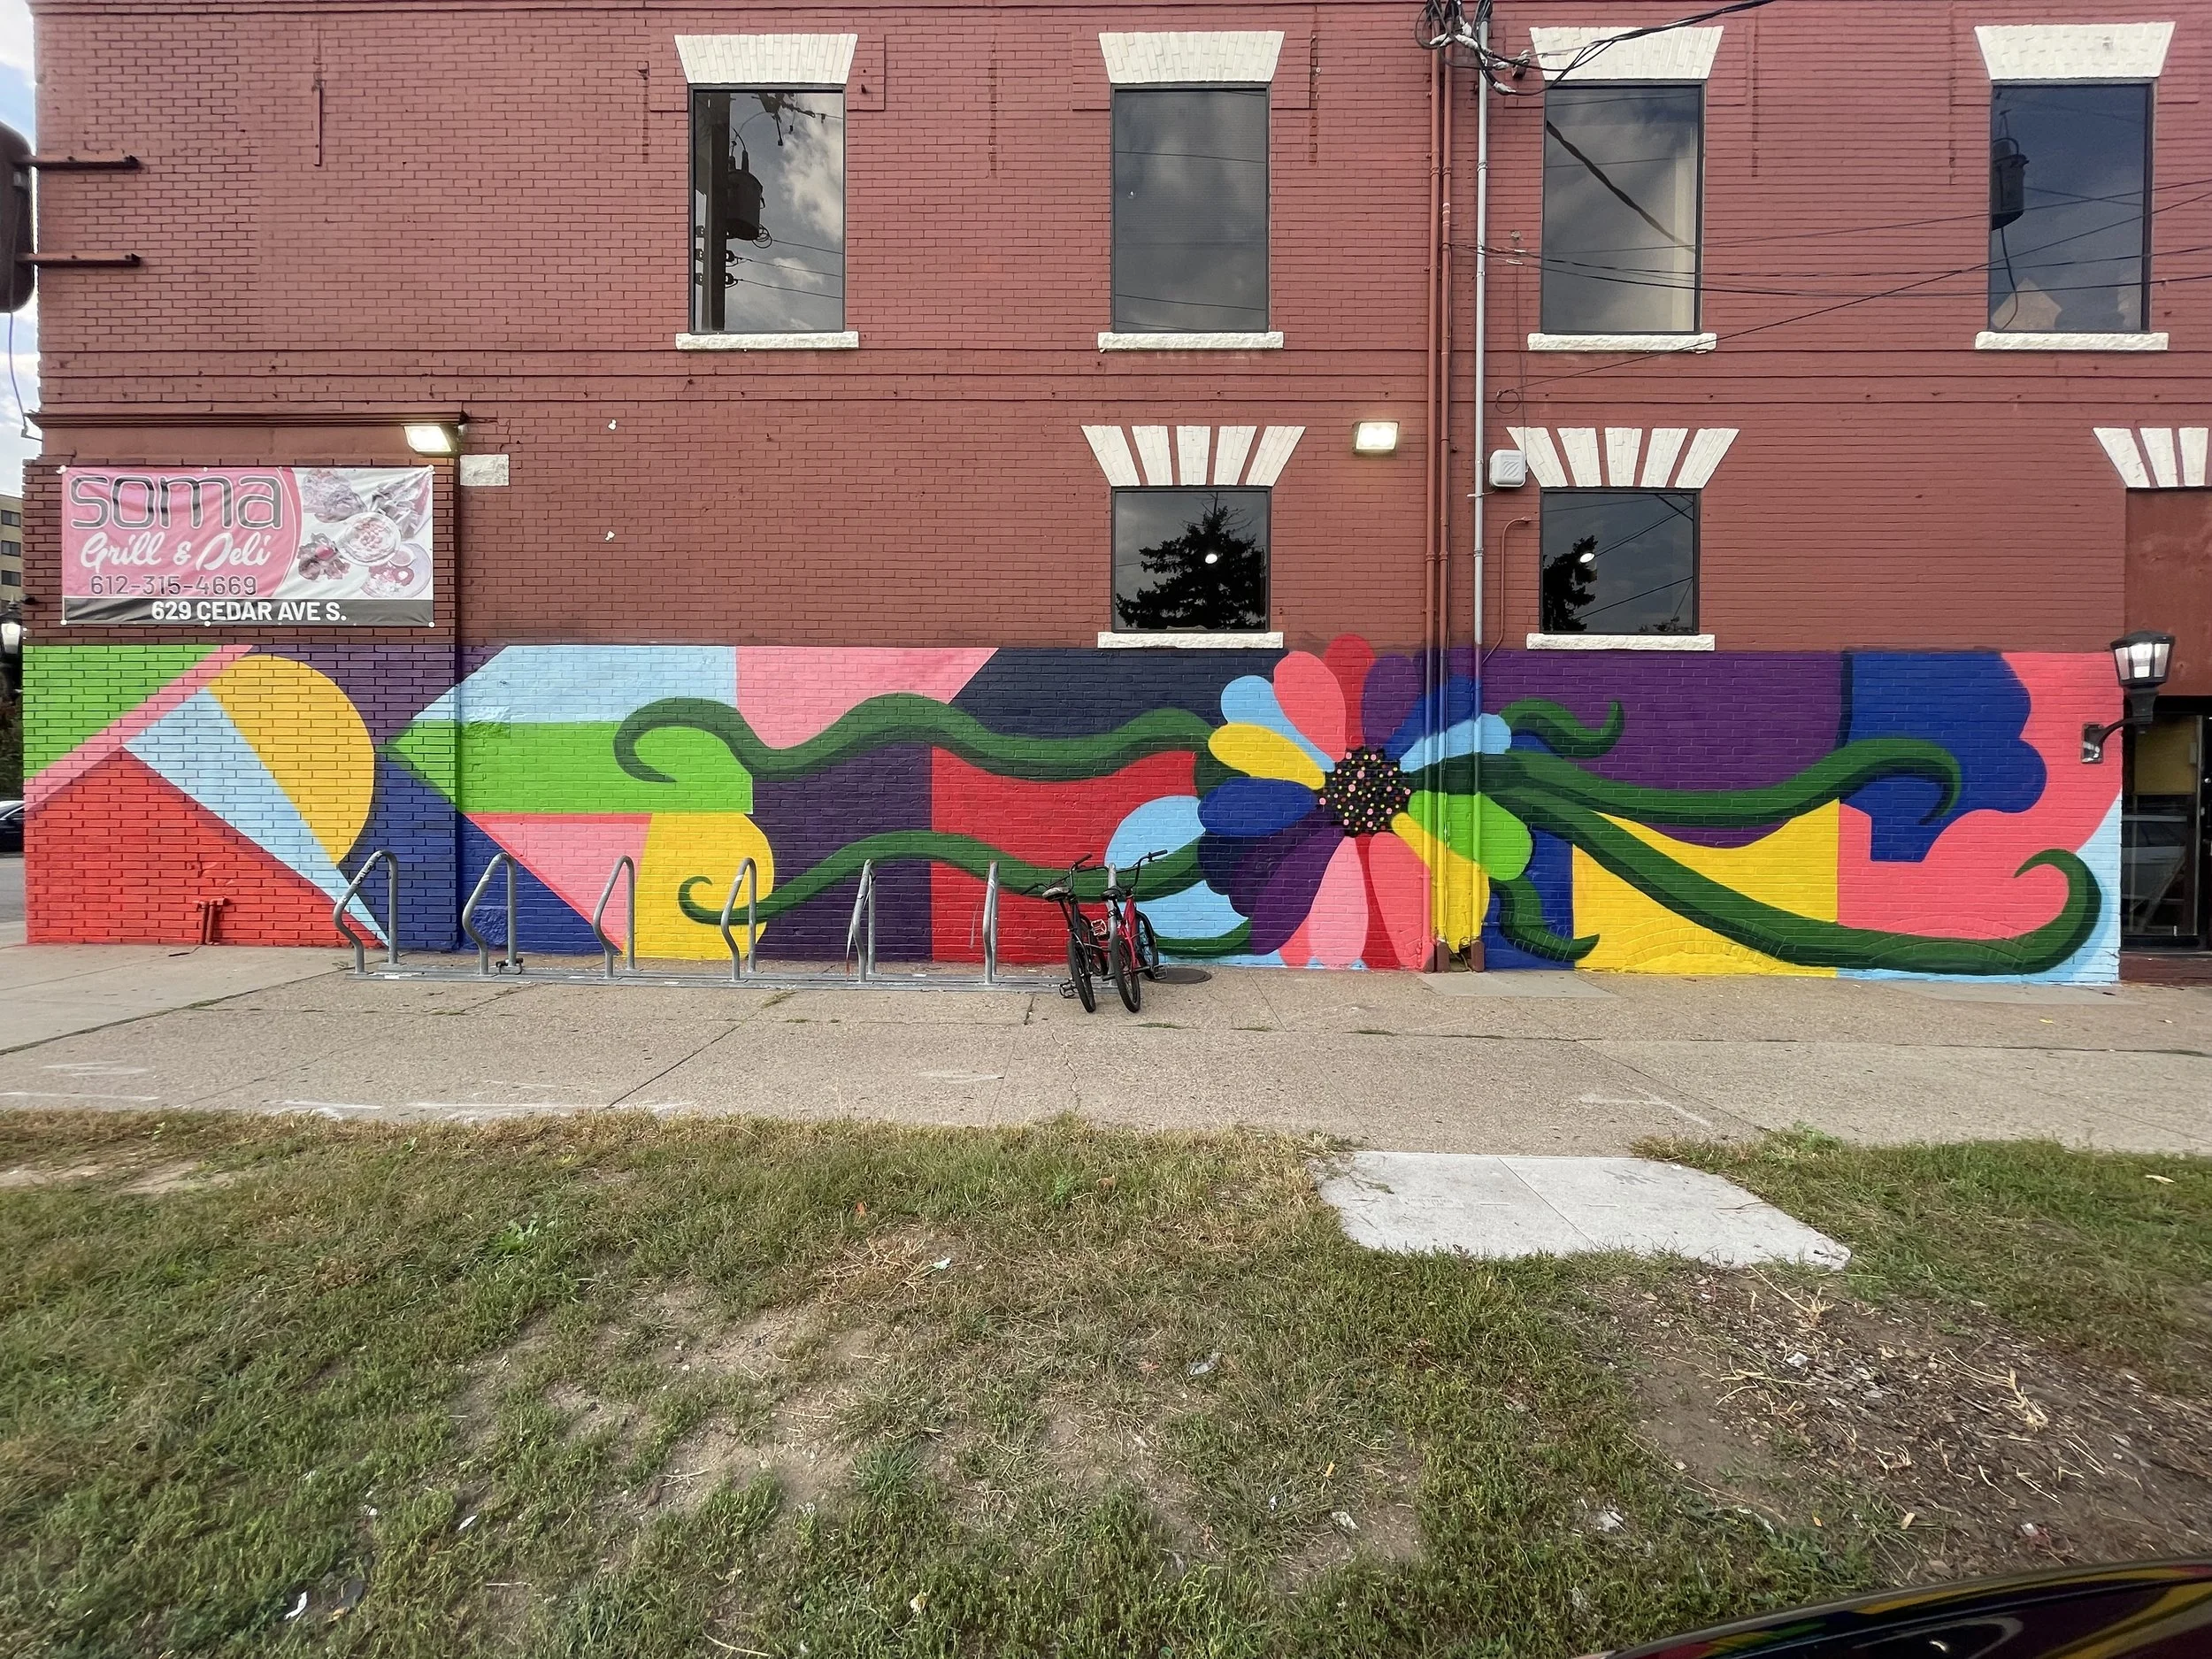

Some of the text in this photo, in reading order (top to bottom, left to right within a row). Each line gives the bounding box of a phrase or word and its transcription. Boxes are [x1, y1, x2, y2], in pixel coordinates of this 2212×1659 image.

[69, 475, 283, 530] soma
[80, 531, 273, 572] Grill & Deli
[90, 574, 257, 595] 612-315-4669
[151, 600, 347, 622] 629 CEDAR AVE S.
